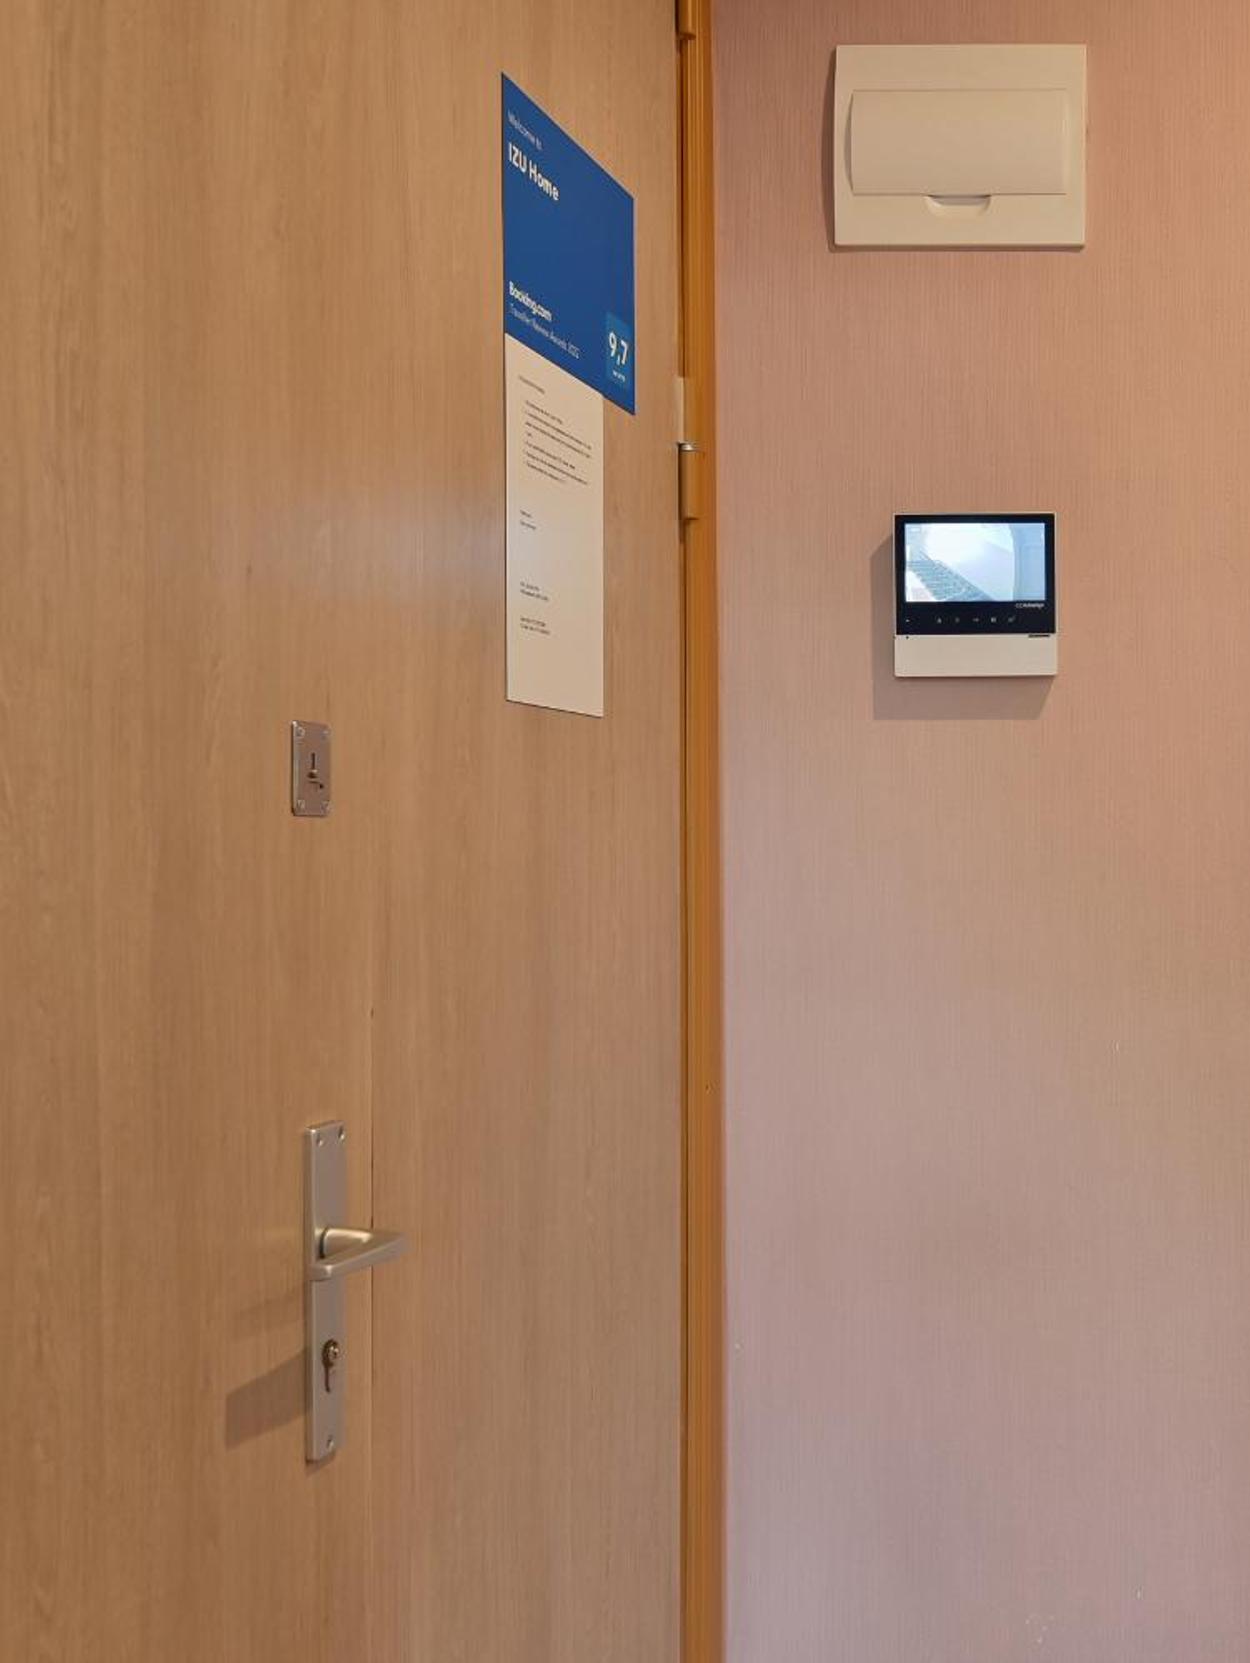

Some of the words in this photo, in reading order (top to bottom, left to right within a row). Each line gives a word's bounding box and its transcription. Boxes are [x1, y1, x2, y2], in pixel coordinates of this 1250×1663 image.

[508, 142, 527, 174] IZU
[529, 160, 560, 201] Home
[509, 281, 552, 322] Booking.com
[608, 331, 628, 366] 9,7
